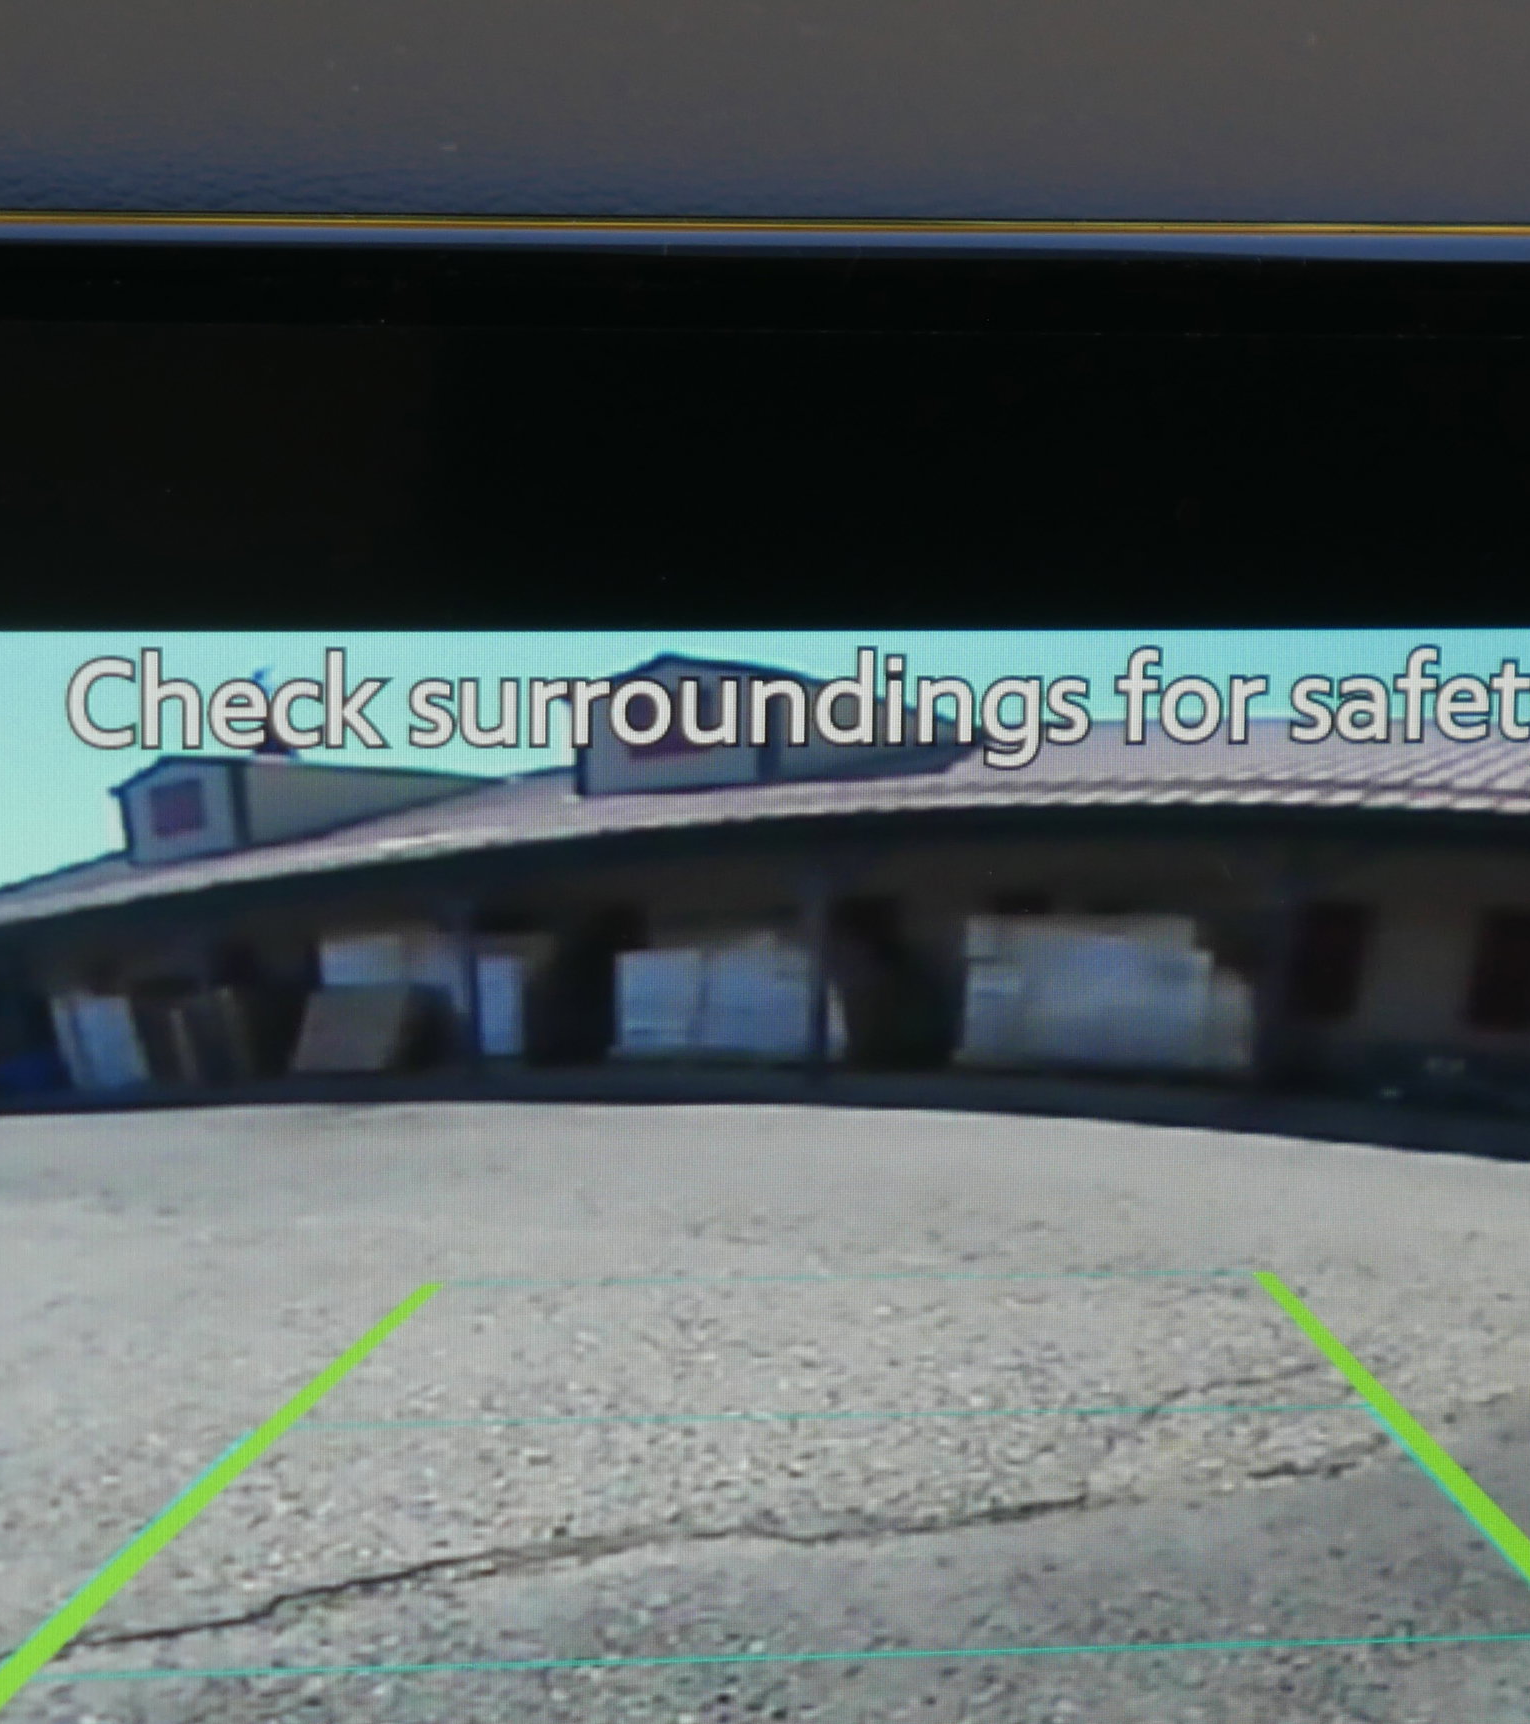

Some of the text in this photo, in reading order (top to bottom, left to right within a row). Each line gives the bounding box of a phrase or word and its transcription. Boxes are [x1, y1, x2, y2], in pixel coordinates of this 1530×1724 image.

[66, 647, 391, 749] Check
[407, 646, 1091, 770] surroundings
[1114, 645, 1269, 745] for
